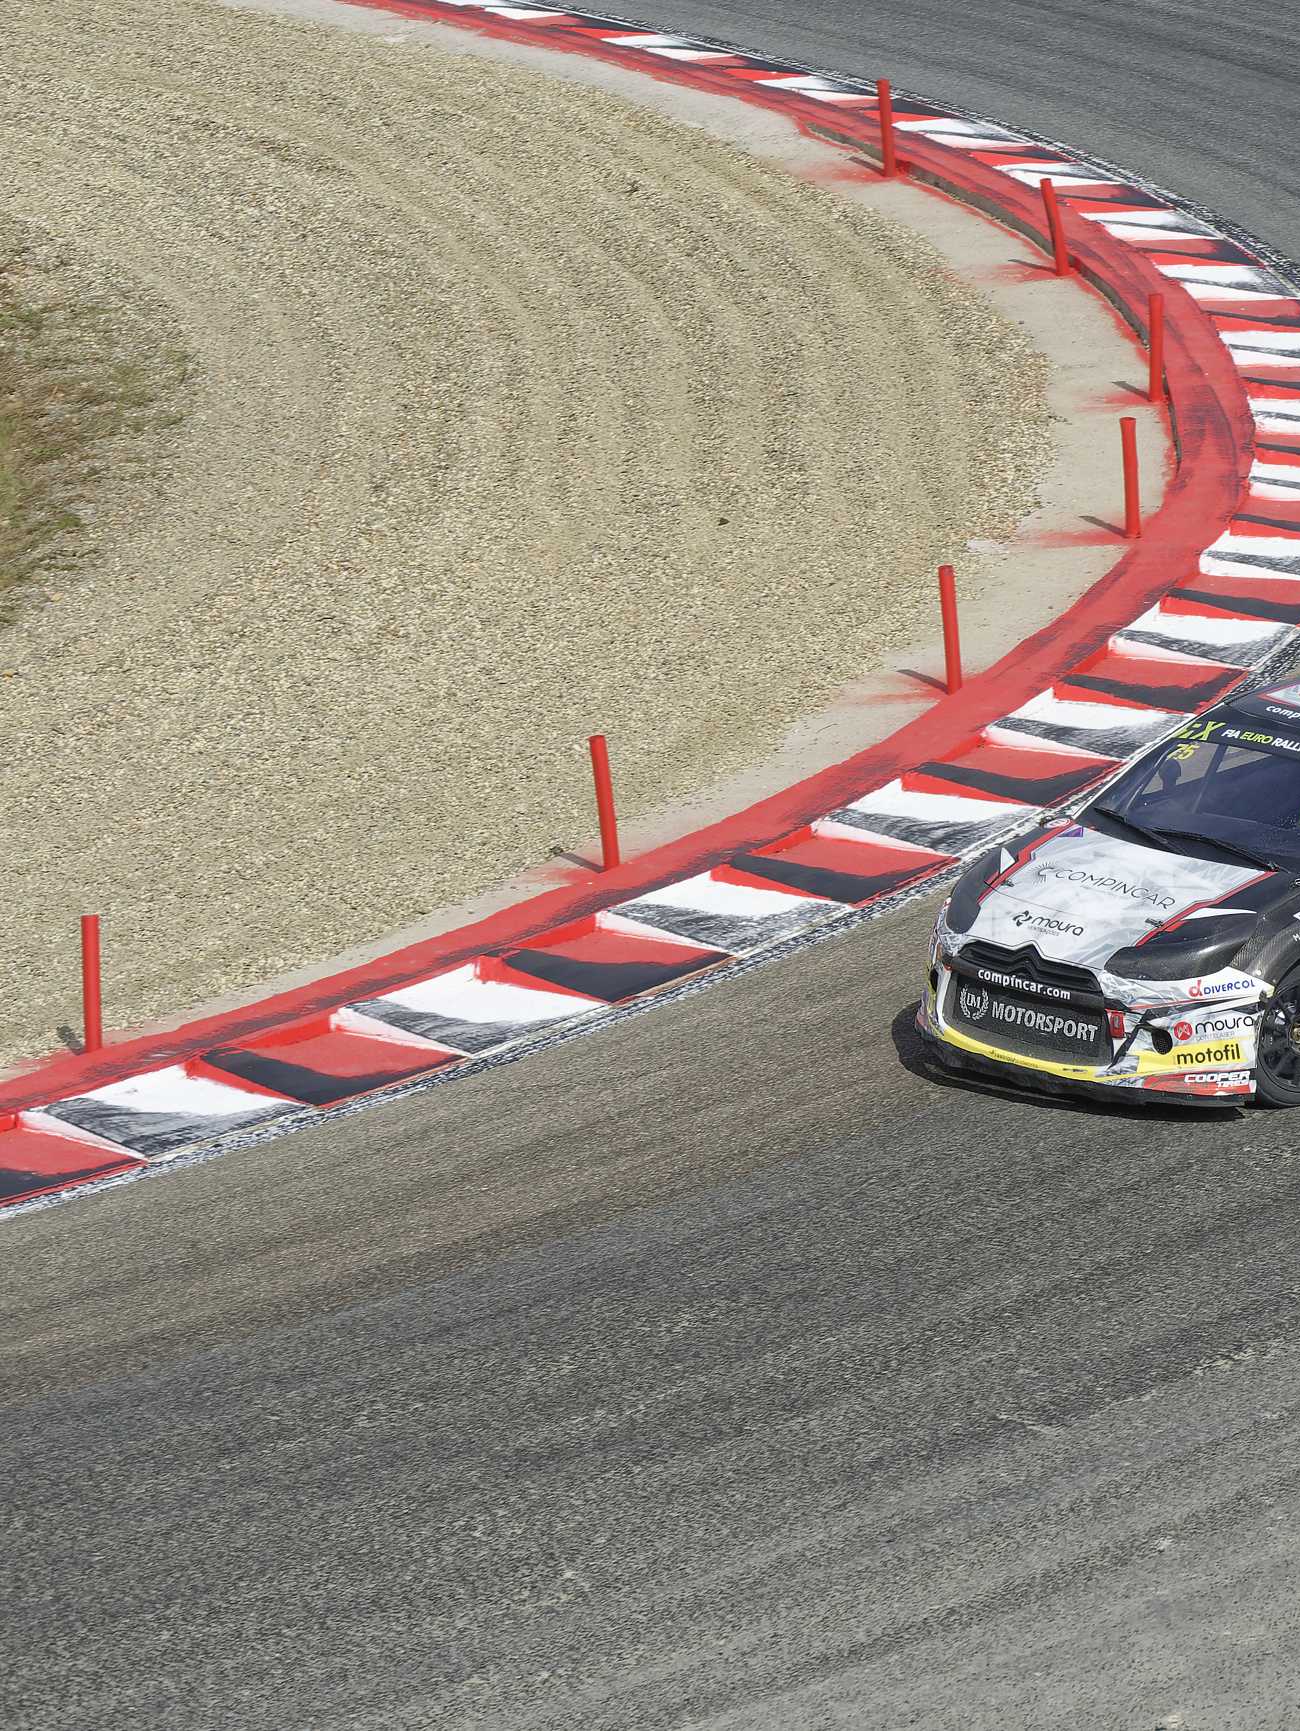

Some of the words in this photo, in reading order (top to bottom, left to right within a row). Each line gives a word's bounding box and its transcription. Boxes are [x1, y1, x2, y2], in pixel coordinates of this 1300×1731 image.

[1221, 729, 1242, 739] FIA
[1240, 731, 1274, 744] EURO
[1055, 869, 1176, 910] COMPINCAR
[978, 969, 1071, 1000] compincar.com
[1203, 979, 1256, 995] DIVERCOL
[991, 1001, 1099, 1042] MOTORSPORT
[1195, 1016, 1254, 1035] moura
[1177, 1043, 1241, 1065] motofil
[1184, 1071, 1251, 1083] COOPER
